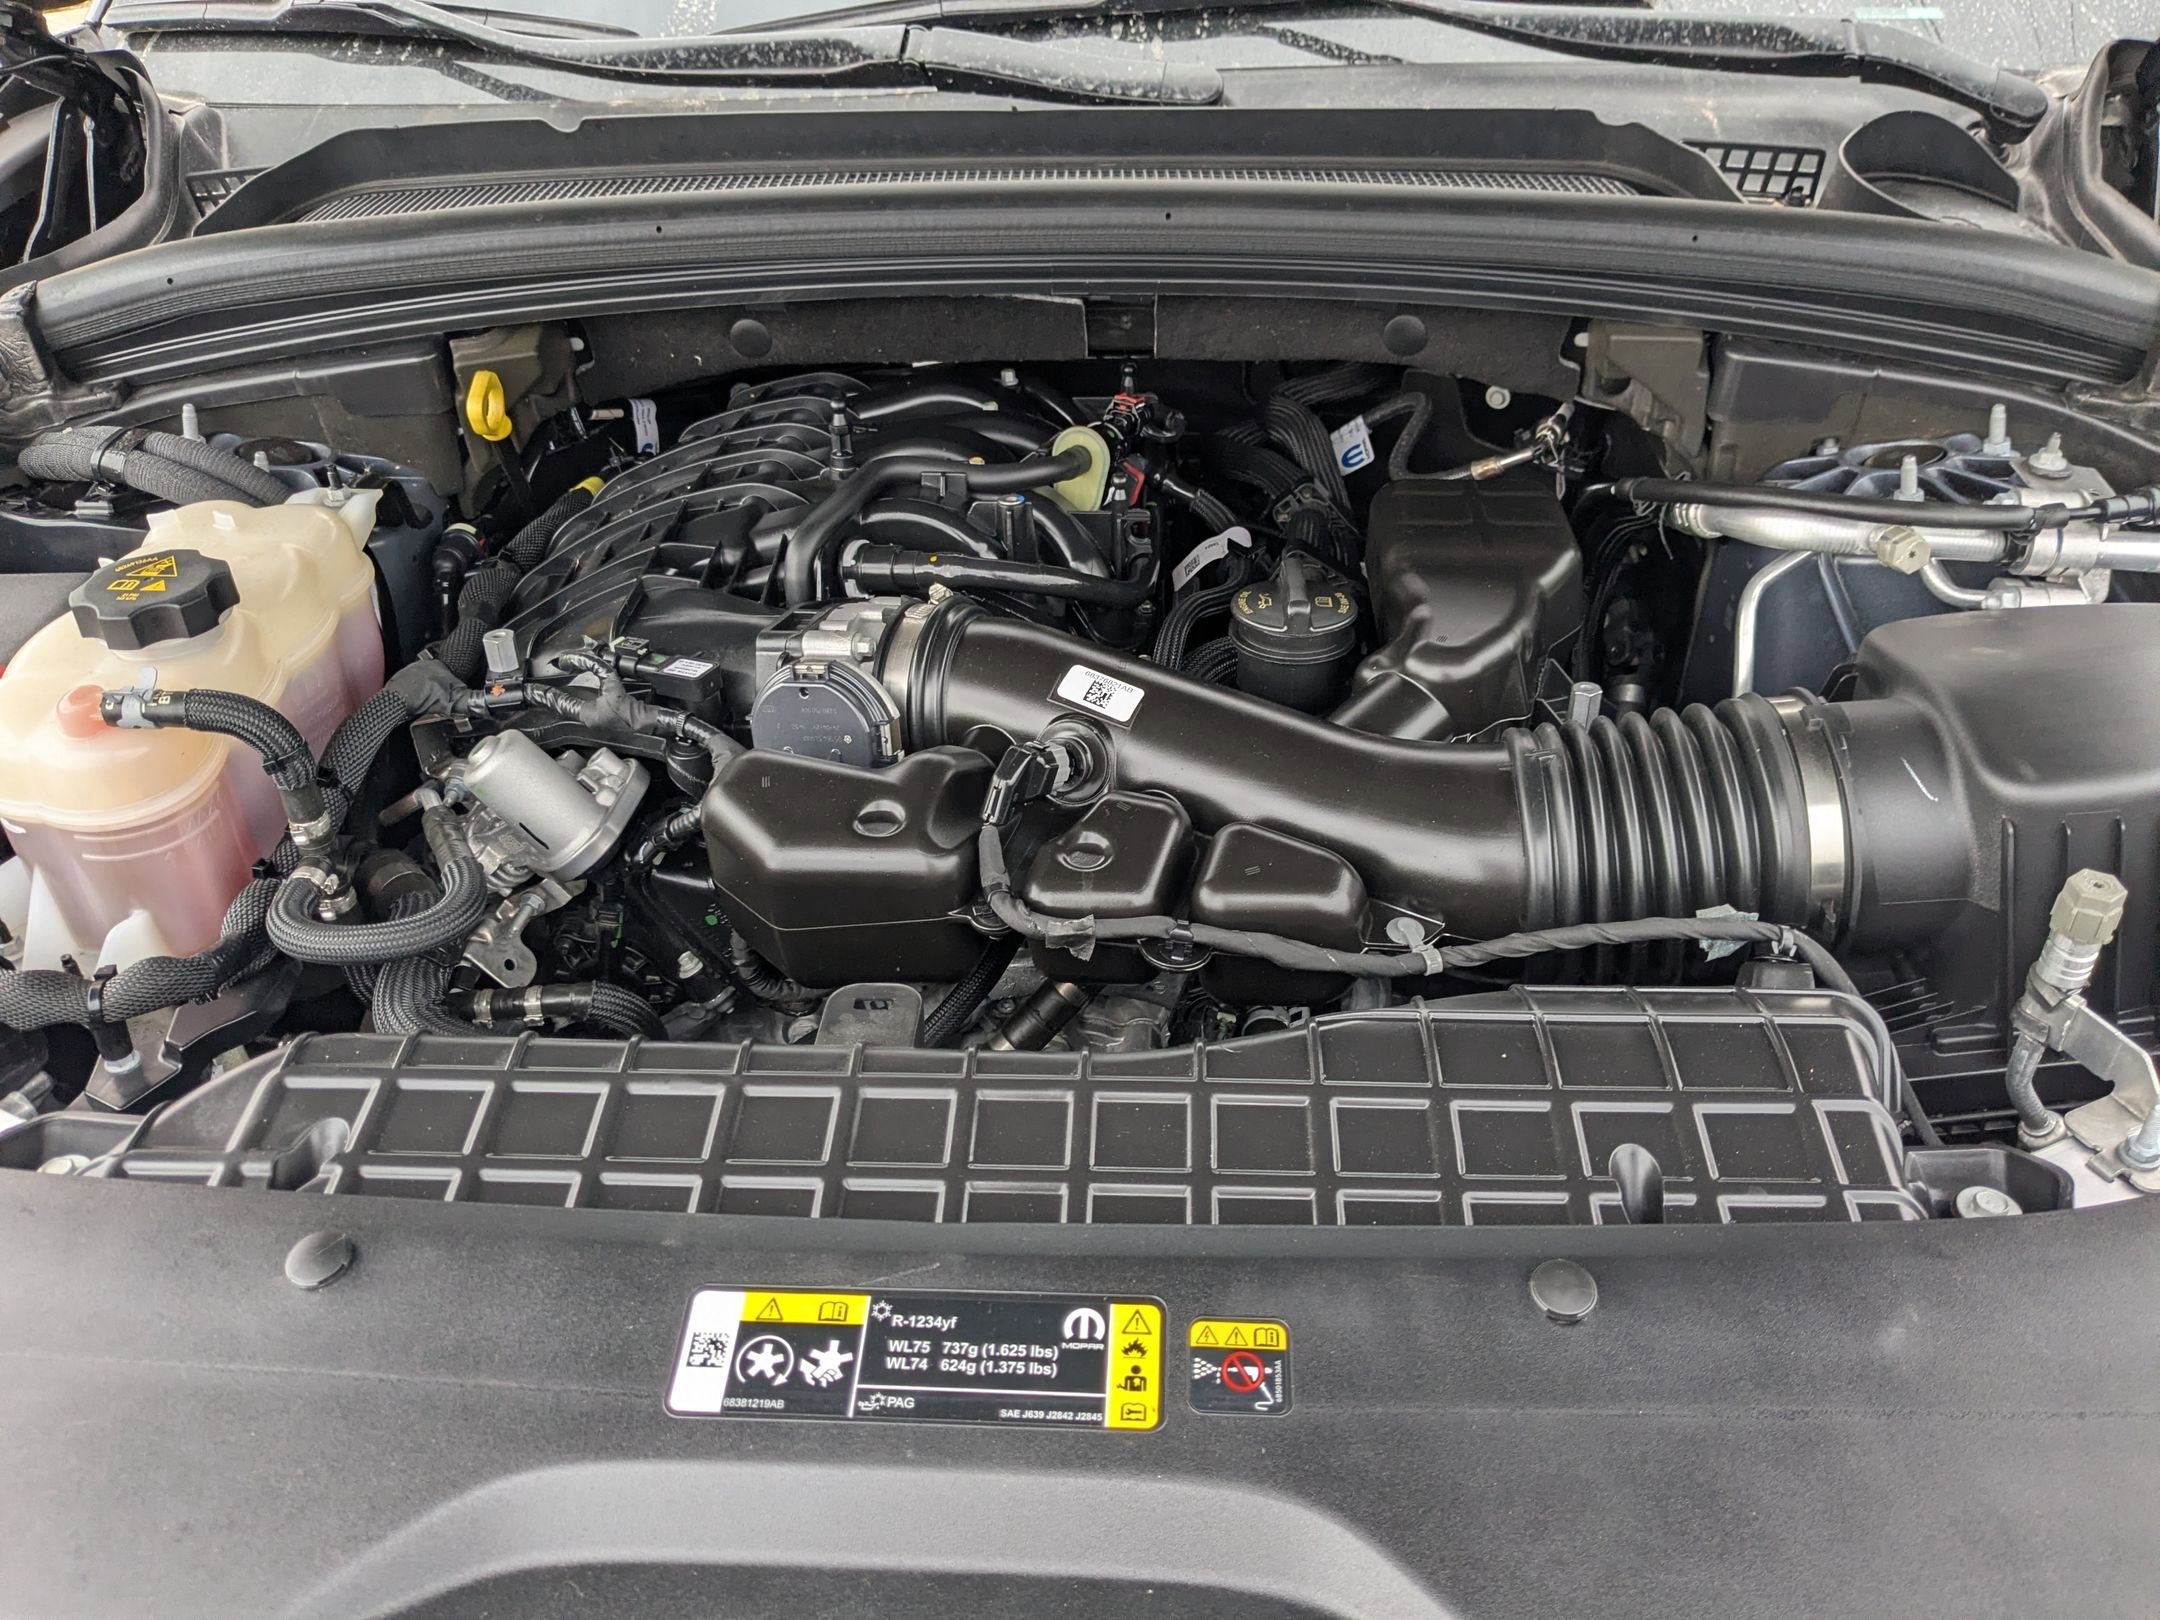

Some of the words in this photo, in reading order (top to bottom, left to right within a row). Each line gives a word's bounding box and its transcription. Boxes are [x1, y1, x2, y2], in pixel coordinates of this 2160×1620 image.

[891, 1314, 958, 1332] R-1234yf
[888, 1339, 931, 1354] WL75
[942, 1341, 979, 1358] 737g
[982, 1343, 1027, 1359] (1.625
[1030, 1344, 1059, 1361] lbs)
[1061, 1341, 1105, 1351] MOPAR
[886, 1356, 929, 1371] WL74
[940, 1358, 977, 1376] 624g
[980, 1360, 1026, 1377] (1.375
[1029, 1361, 1058, 1379] lbs)
[723, 1397, 785, 1409] 68381219AB
[886, 1396, 916, 1409] PAG
[1000, 1408, 1022, 1418] SAE
[1022, 1409, 1045, 1419] J639
[1046, 1410, 1074, 1421] J2842
[1075, 1411, 1103, 1421] J2845
